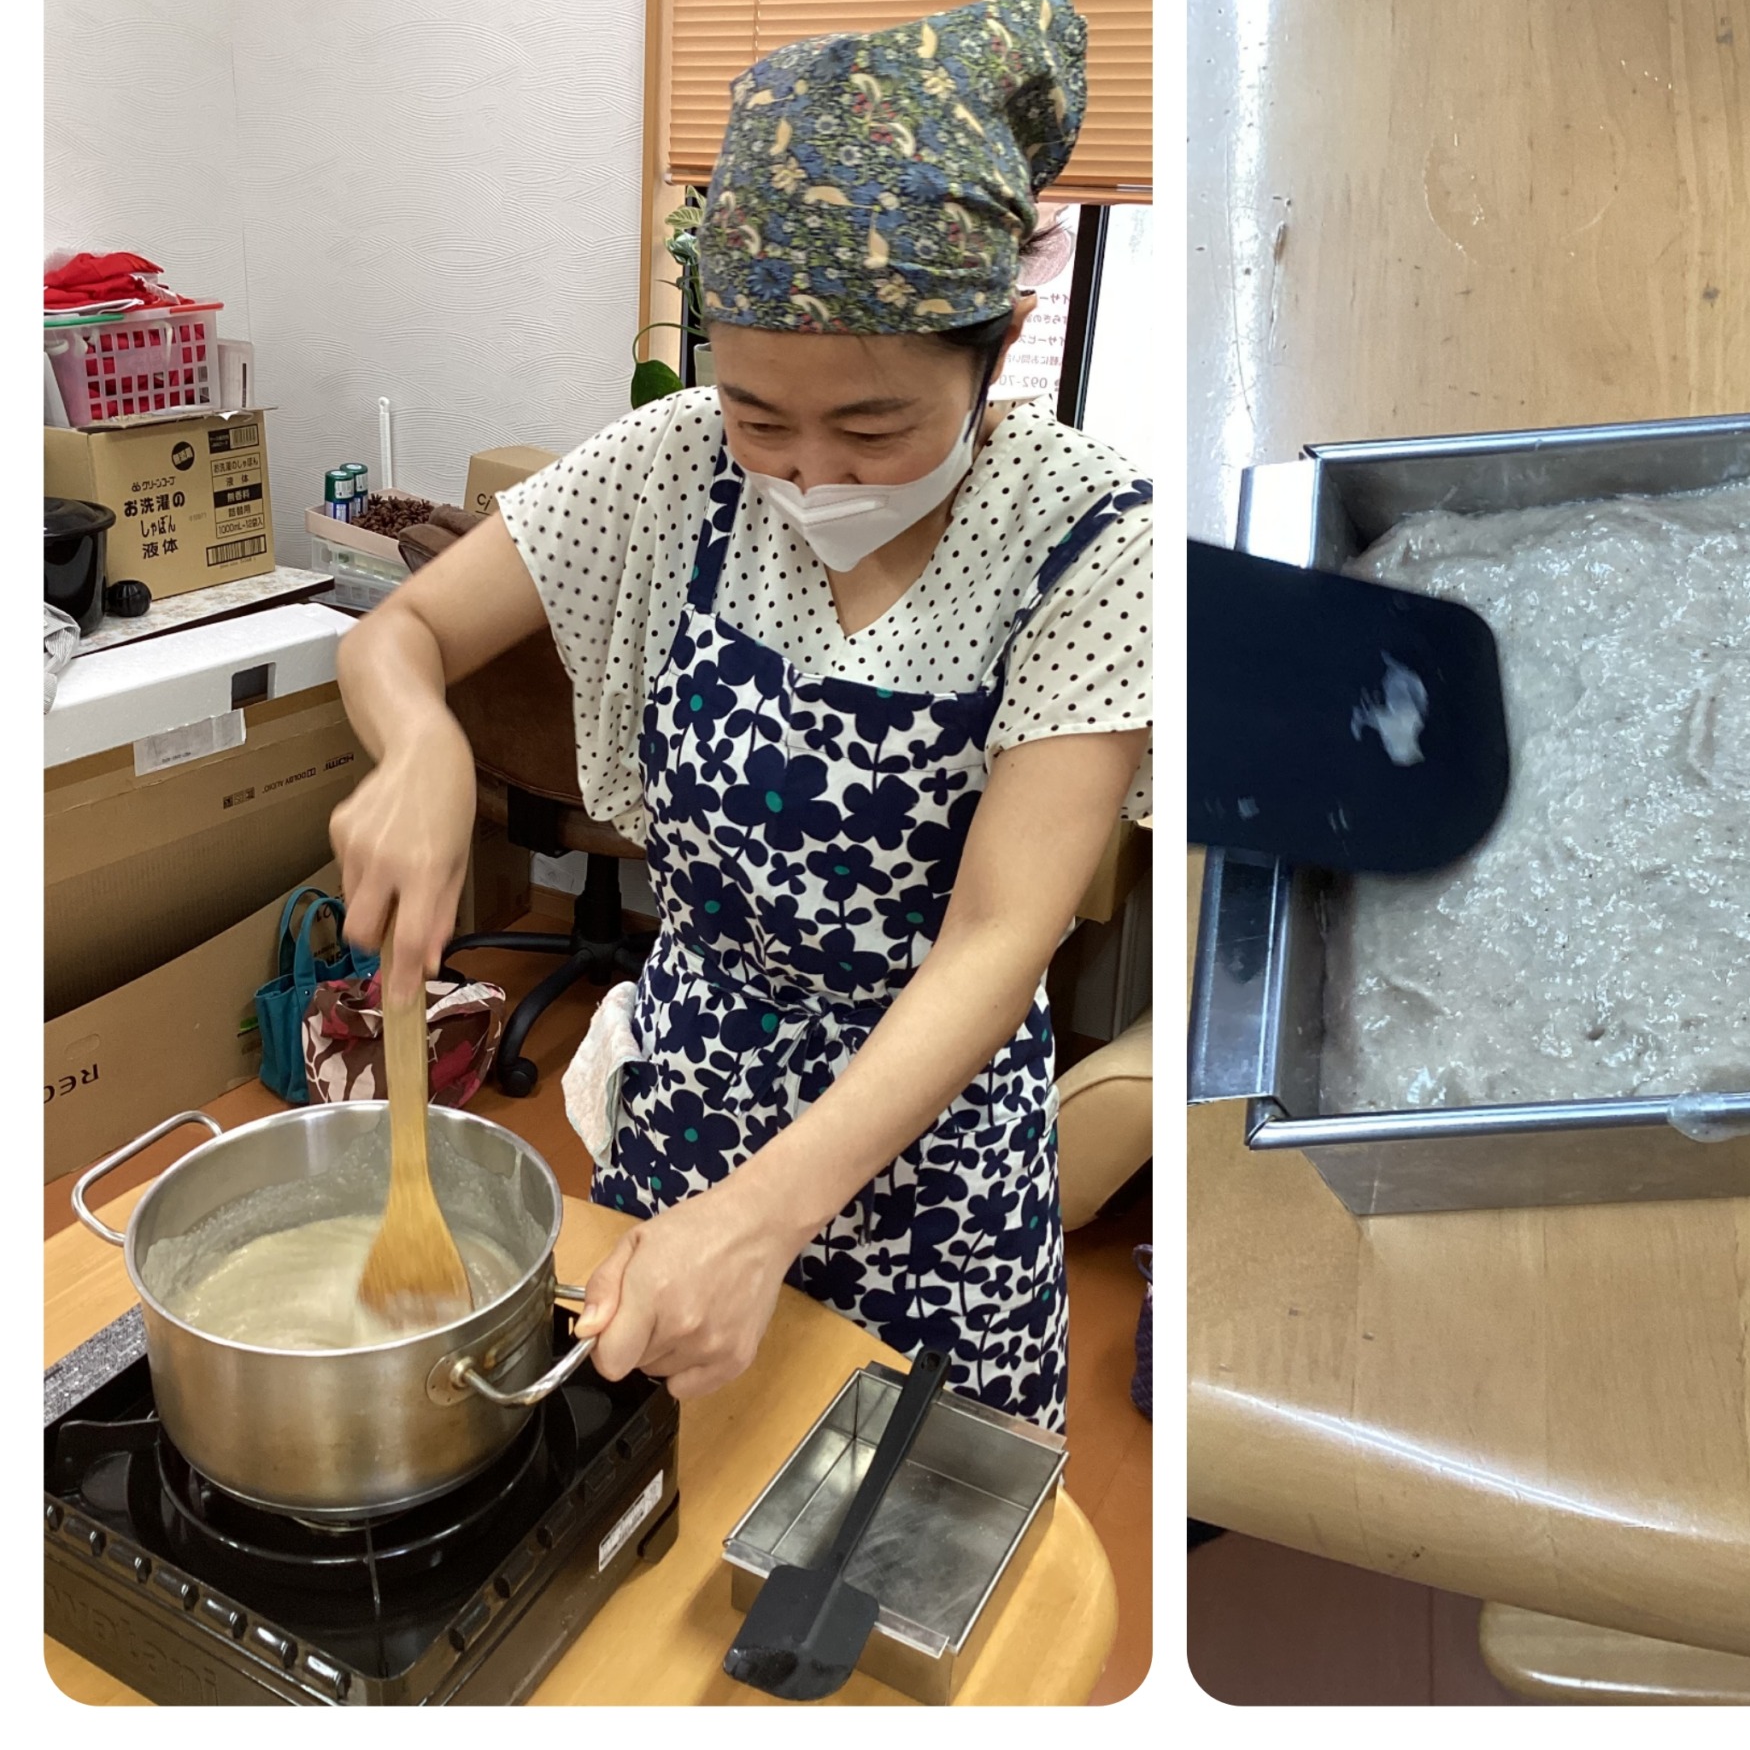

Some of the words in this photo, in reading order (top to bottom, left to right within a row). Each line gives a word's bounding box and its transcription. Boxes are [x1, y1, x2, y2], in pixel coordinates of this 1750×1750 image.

[124, 490, 186, 518] お洗濯の
[140, 514, 176, 539] しゃぼん
[142, 537, 179, 560] 液体
